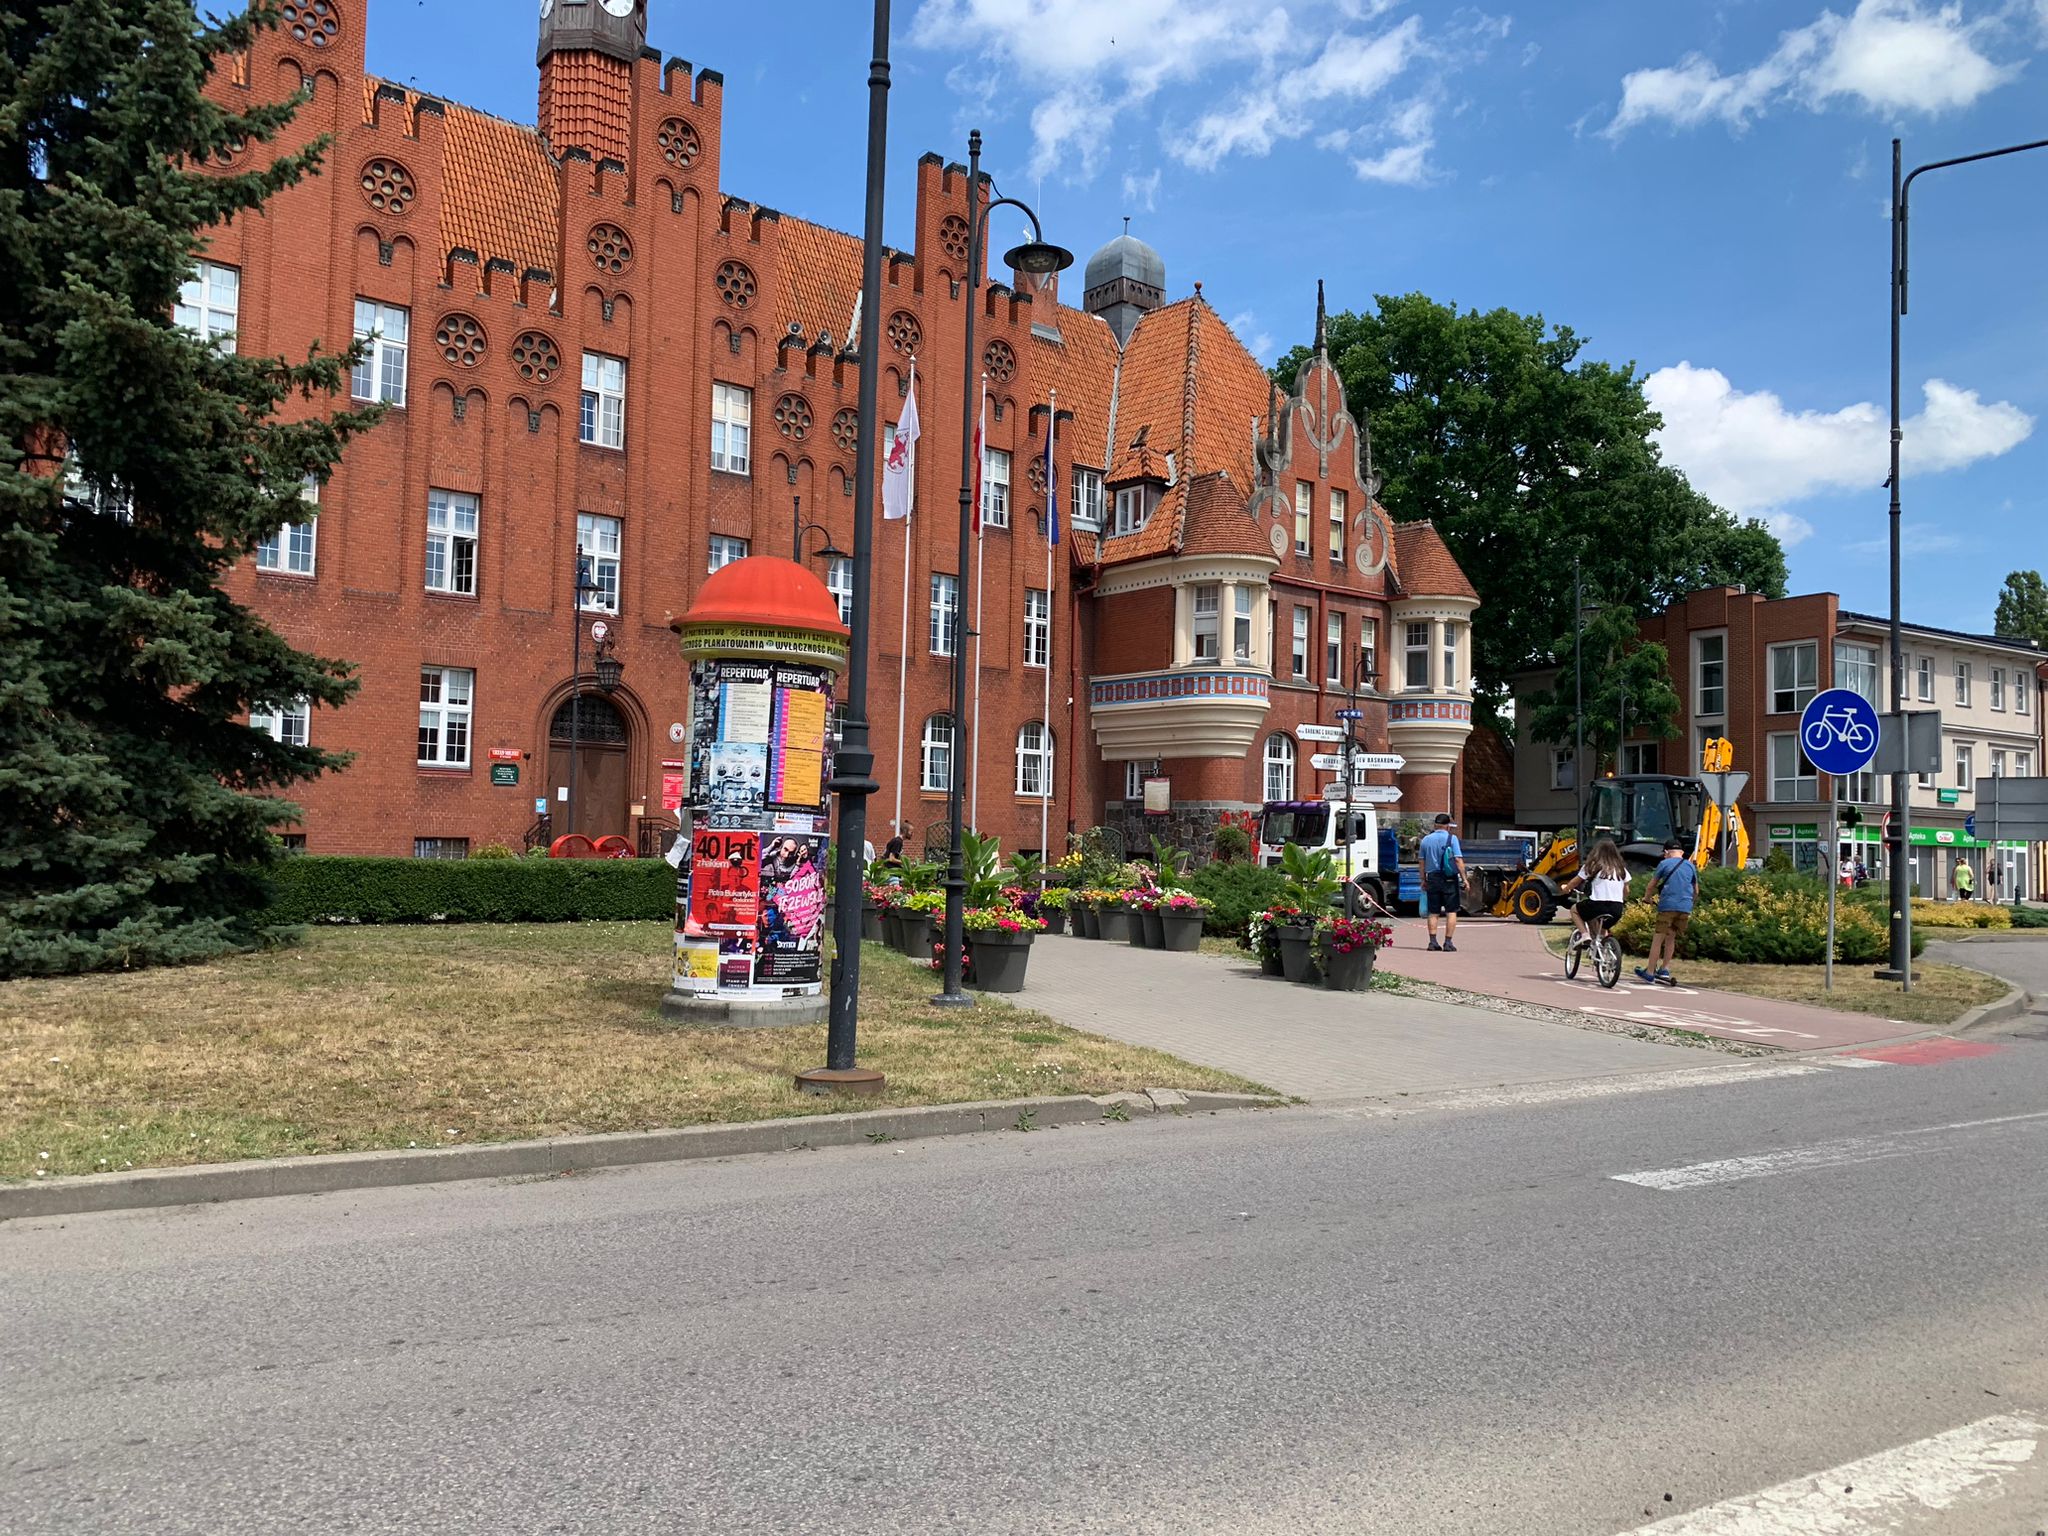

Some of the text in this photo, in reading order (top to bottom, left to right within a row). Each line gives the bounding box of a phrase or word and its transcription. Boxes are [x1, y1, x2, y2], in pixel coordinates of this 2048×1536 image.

[741, 629, 775, 638] CENTRUM
[777, 630, 807, 640] KULTURY
[703, 638, 765, 649] PLAKATOWANIA
[775, 640, 826, 654] WYŁĄCZNOŚĆ
[721, 667, 769, 679] REPERTUAR
[777, 671, 820, 687] REPERTUAR
[1909, 832, 1926, 841] Apteka
[696, 835, 756, 861] 40 lat
